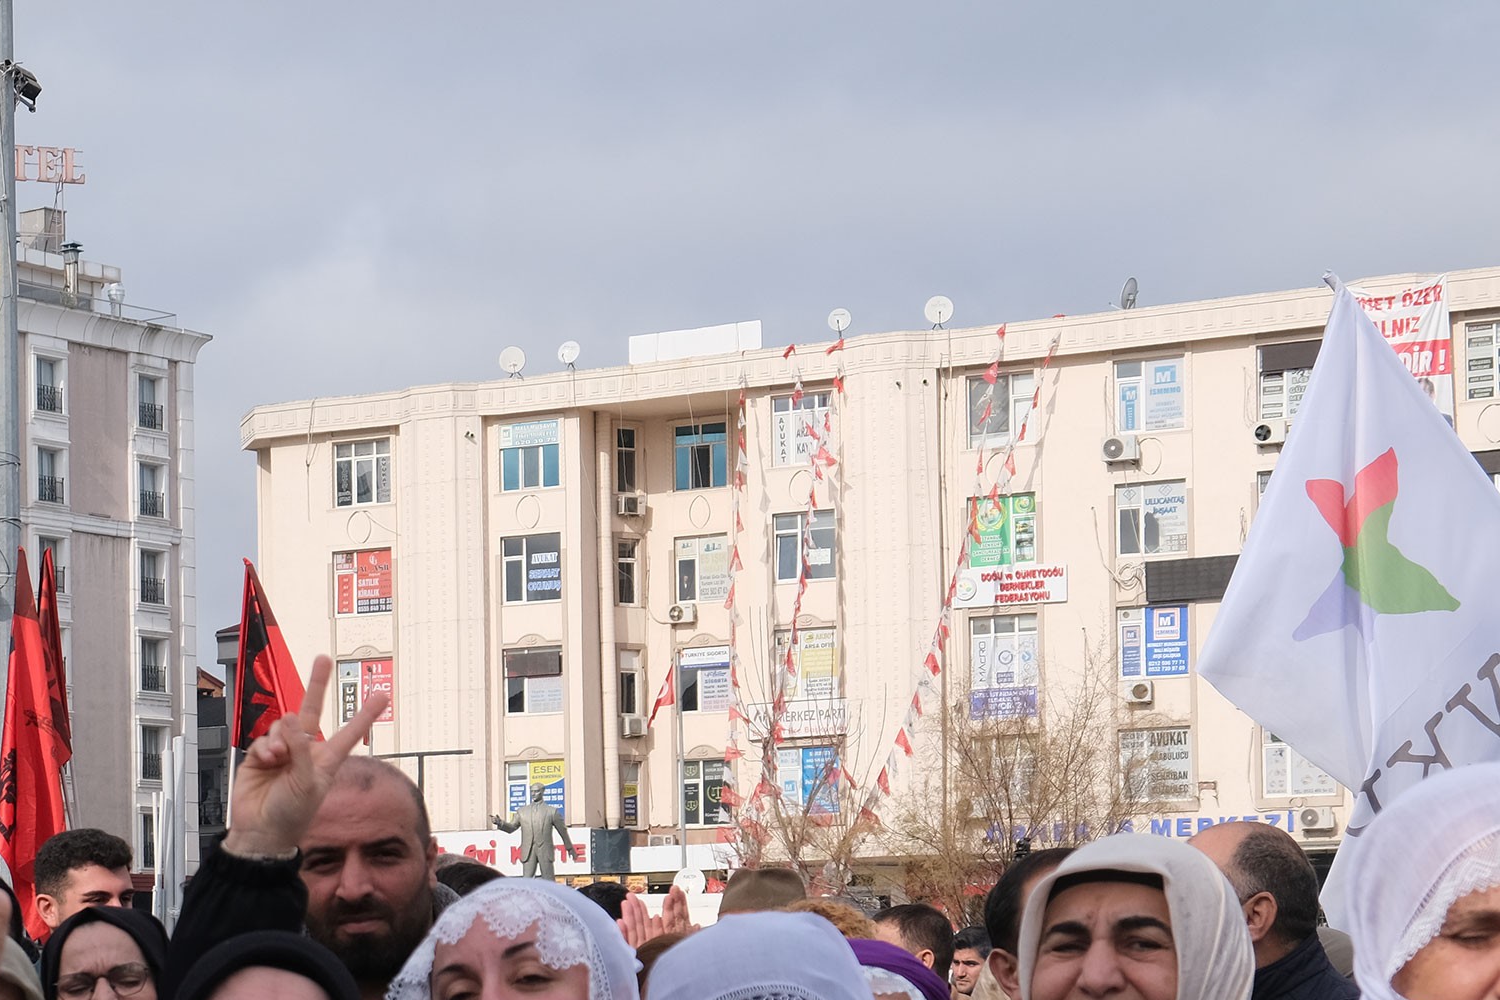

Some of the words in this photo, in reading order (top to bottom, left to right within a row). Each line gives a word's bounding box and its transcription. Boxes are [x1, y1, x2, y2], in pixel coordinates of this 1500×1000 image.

[1355, 295, 1396, 311] MET
[1402, 283, 1443, 308] ÖZER
[779, 417, 787, 463] AVUKAT
[999, 580, 1045, 592] DERNEKLER
[994, 591, 1051, 604] FEDERASYONU
[1150, 730, 1189, 747] AVUKAT
[533, 765, 562, 774] ESEN
[510, 843, 587, 864] KTE
